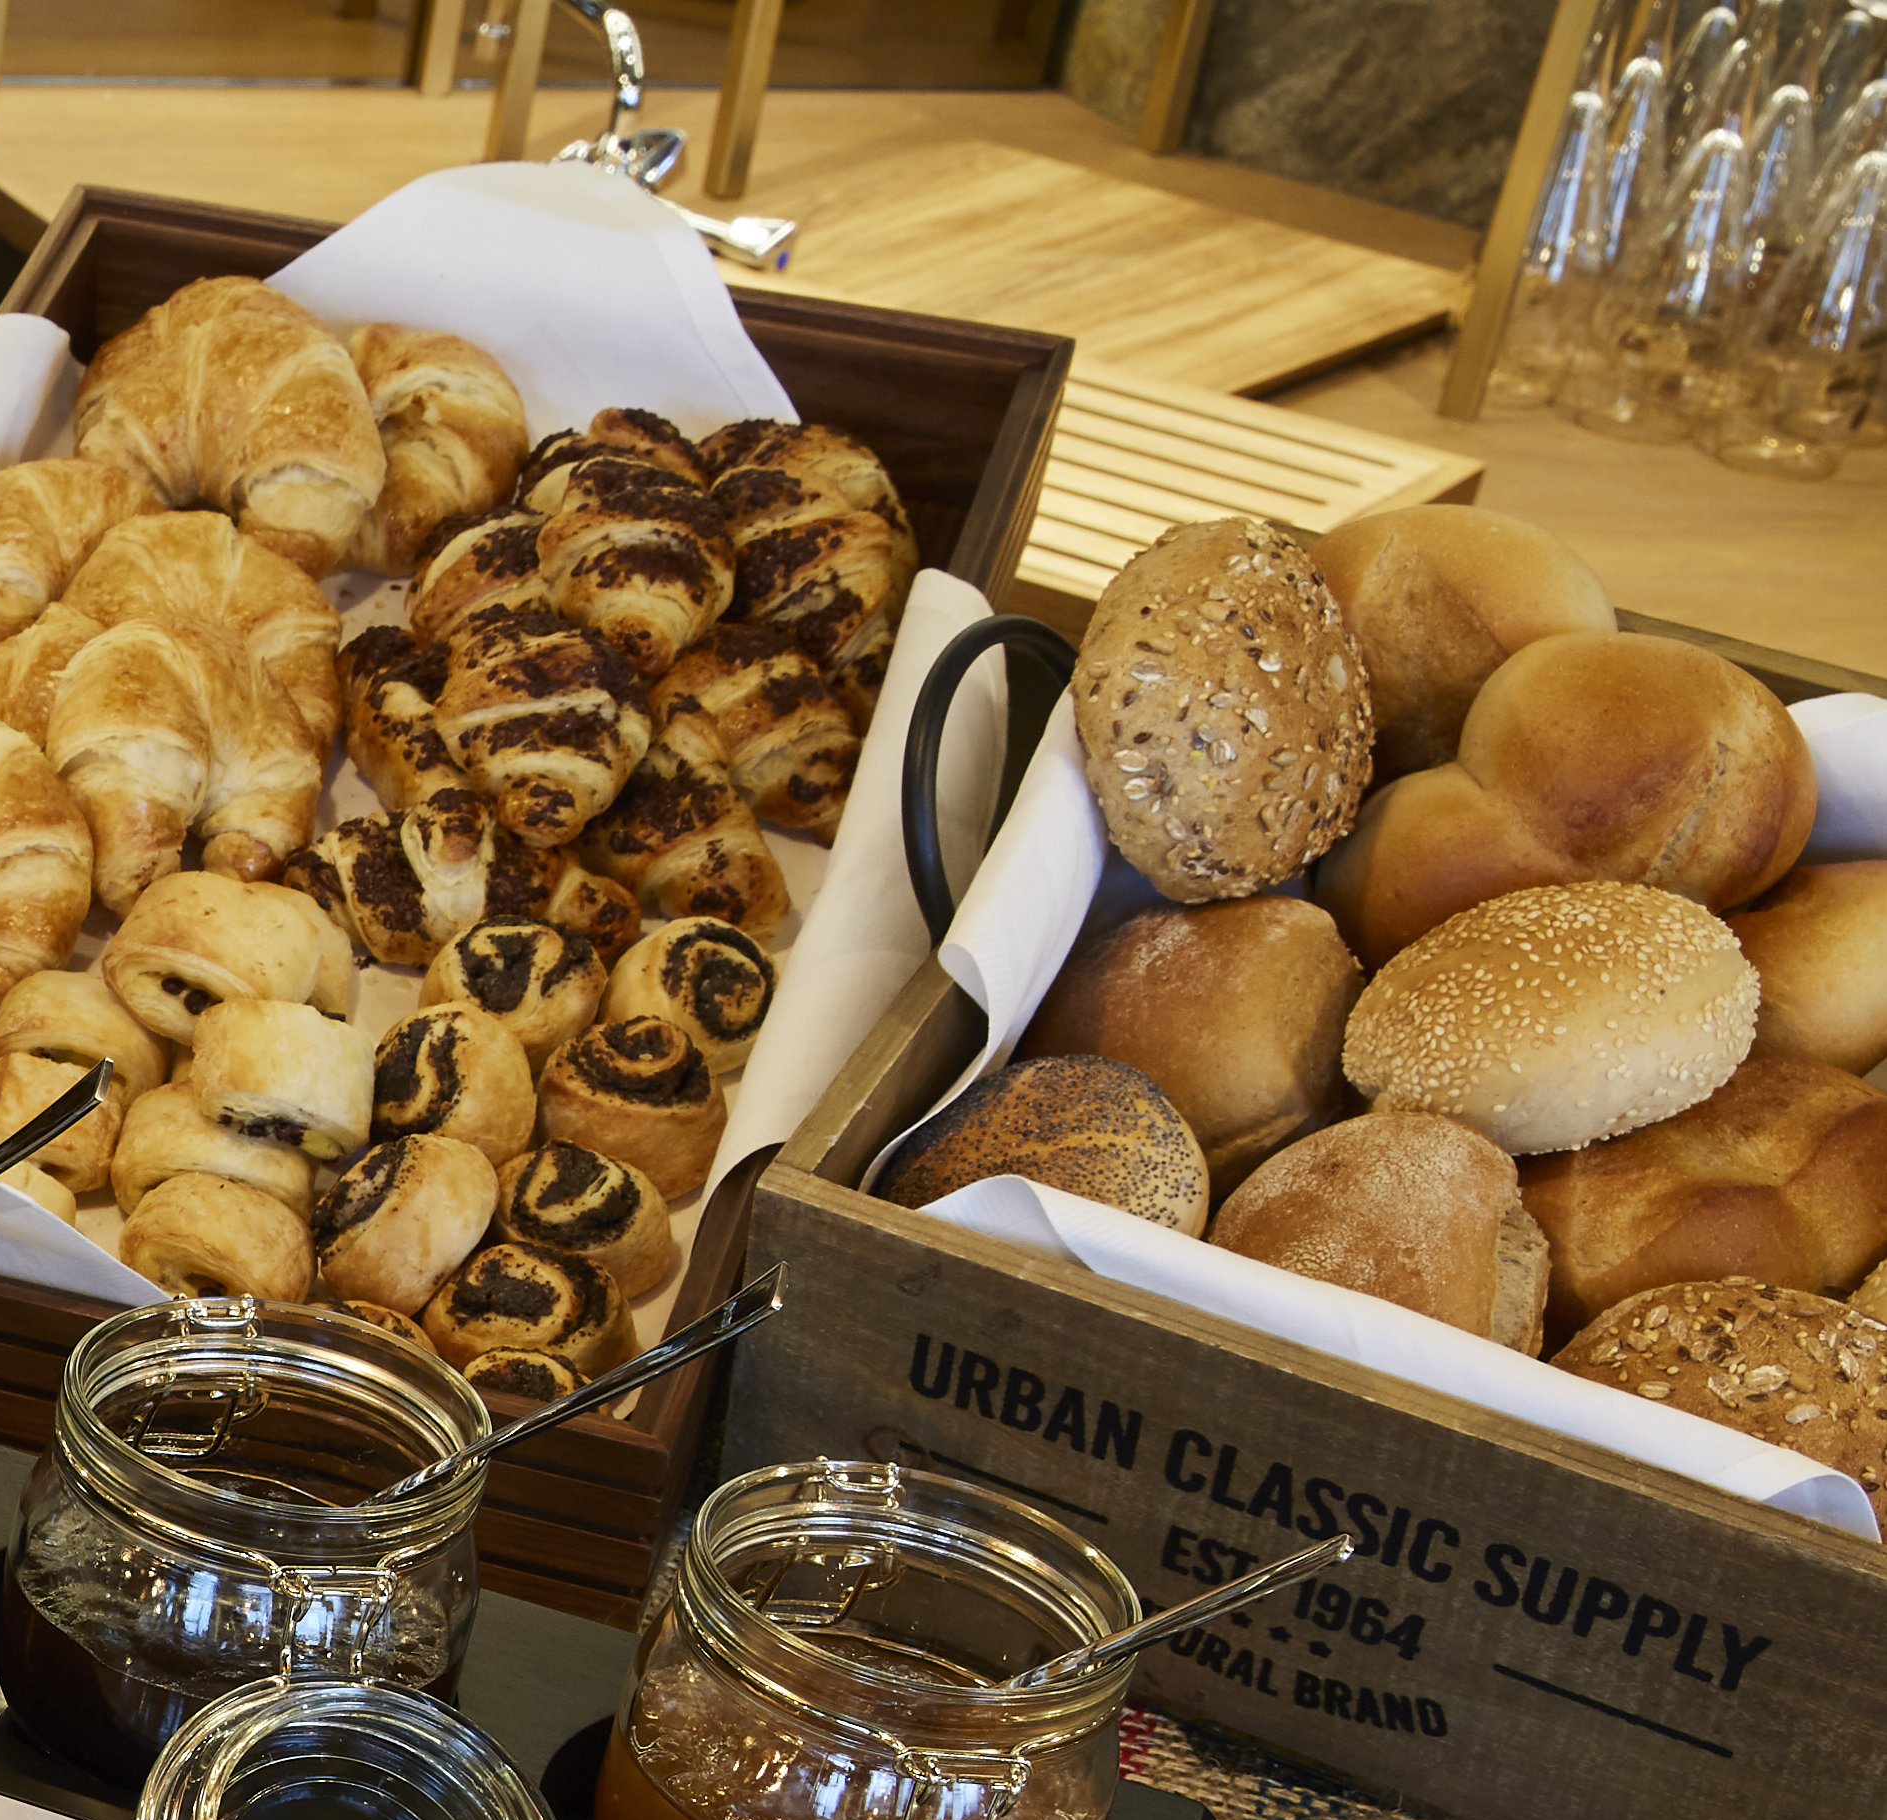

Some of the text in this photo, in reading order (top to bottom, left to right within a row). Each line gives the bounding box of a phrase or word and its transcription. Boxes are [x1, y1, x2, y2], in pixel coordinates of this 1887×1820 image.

[909, 1332, 1771, 1693] URBAN CLASSIC SUPPLY
[1293, 1577, 1426, 1662] 1964
[1293, 1670, 1448, 1738] BRAND
